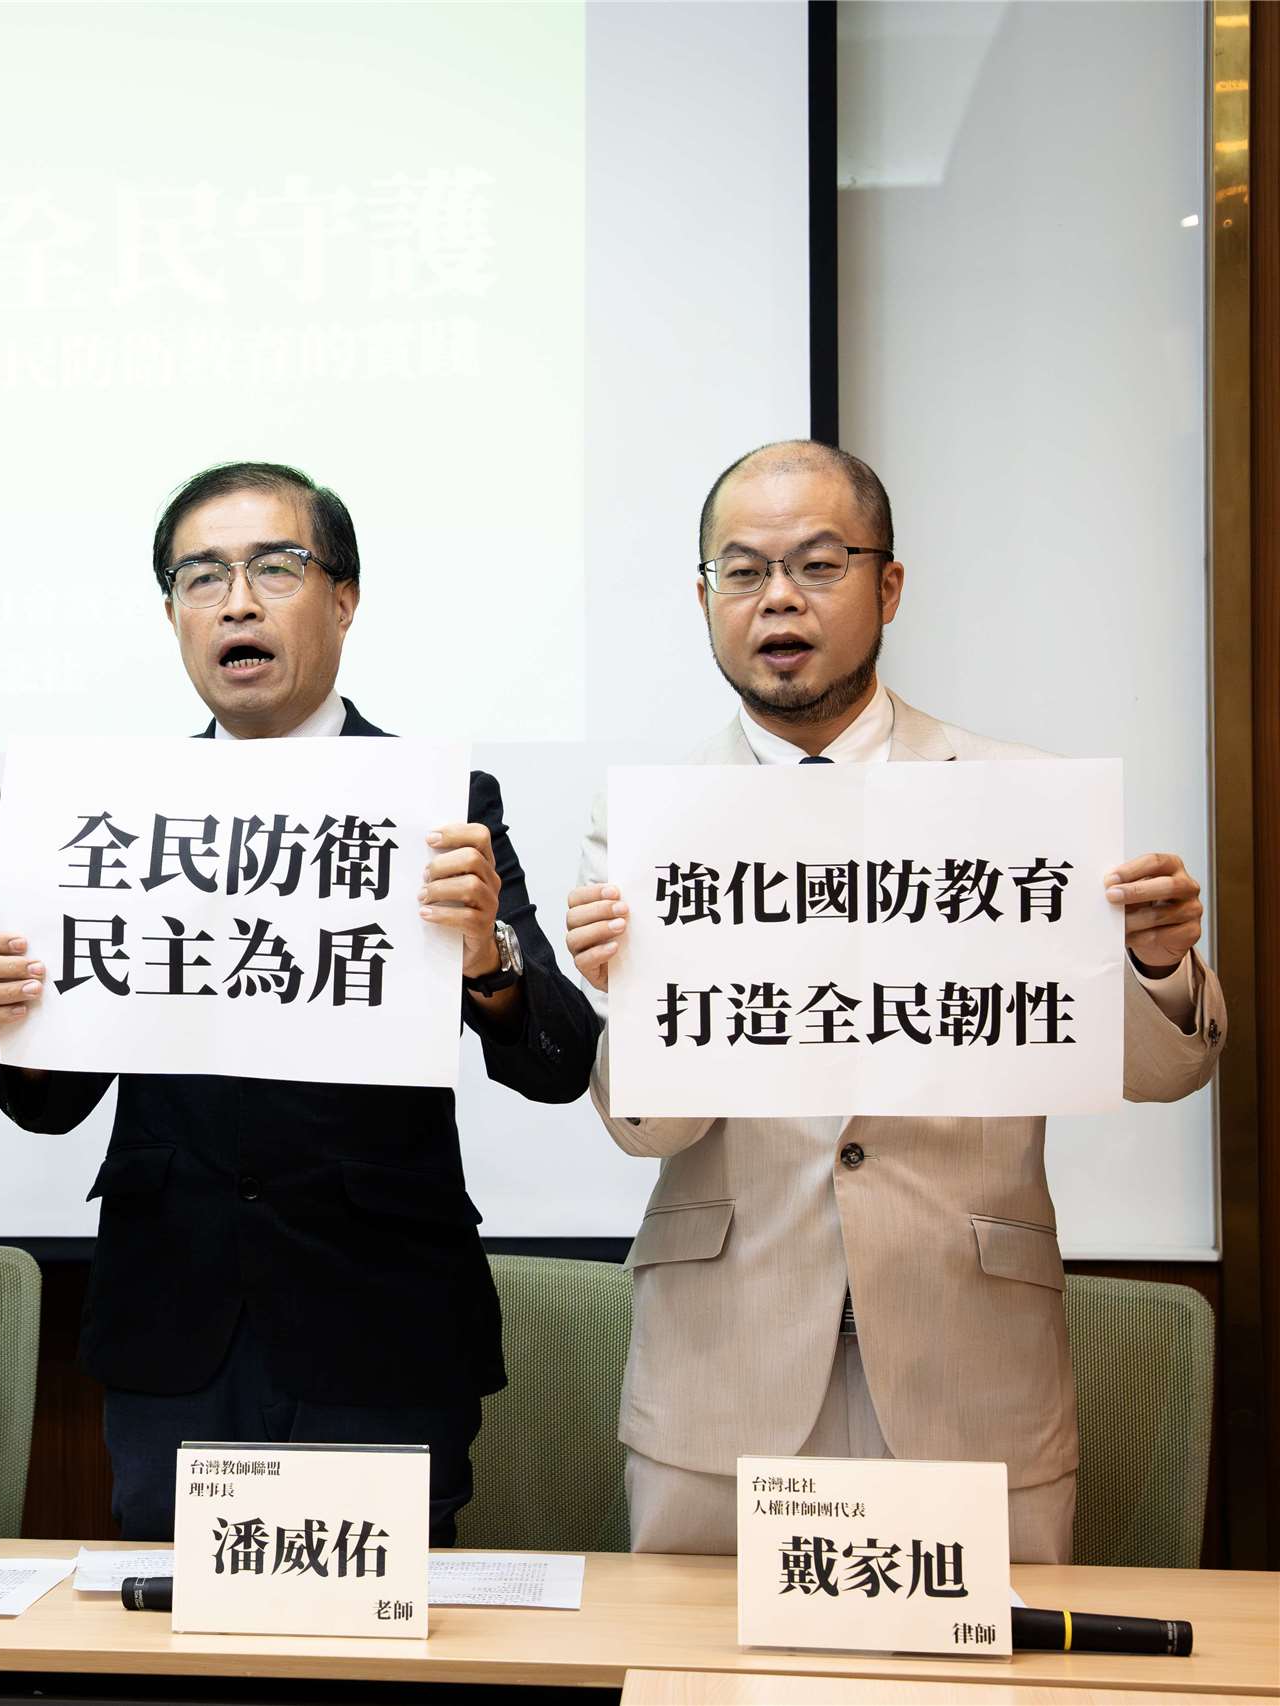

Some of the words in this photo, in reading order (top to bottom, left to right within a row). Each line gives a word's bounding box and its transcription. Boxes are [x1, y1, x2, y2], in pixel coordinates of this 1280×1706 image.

[59, 812, 399, 900] 全民防衛
[655, 858, 1073, 926] 強化國防教育
[54, 914, 394, 1006] 民主為盾
[657, 981, 1076, 1047] 打造全民韌性
[191, 1460, 280, 1475] 台灣教師聯盟
[753, 1477, 815, 1492] 台灣北社
[189, 1483, 233, 1497] 理事長
[753, 1500, 864, 1517] 人權律師團代表
[213, 1518, 389, 1577] 潘威佑
[779, 1536, 968, 1598] 戴家旭
[374, 1600, 412, 1620] 老師
[954, 1623, 995, 1644] 律師
